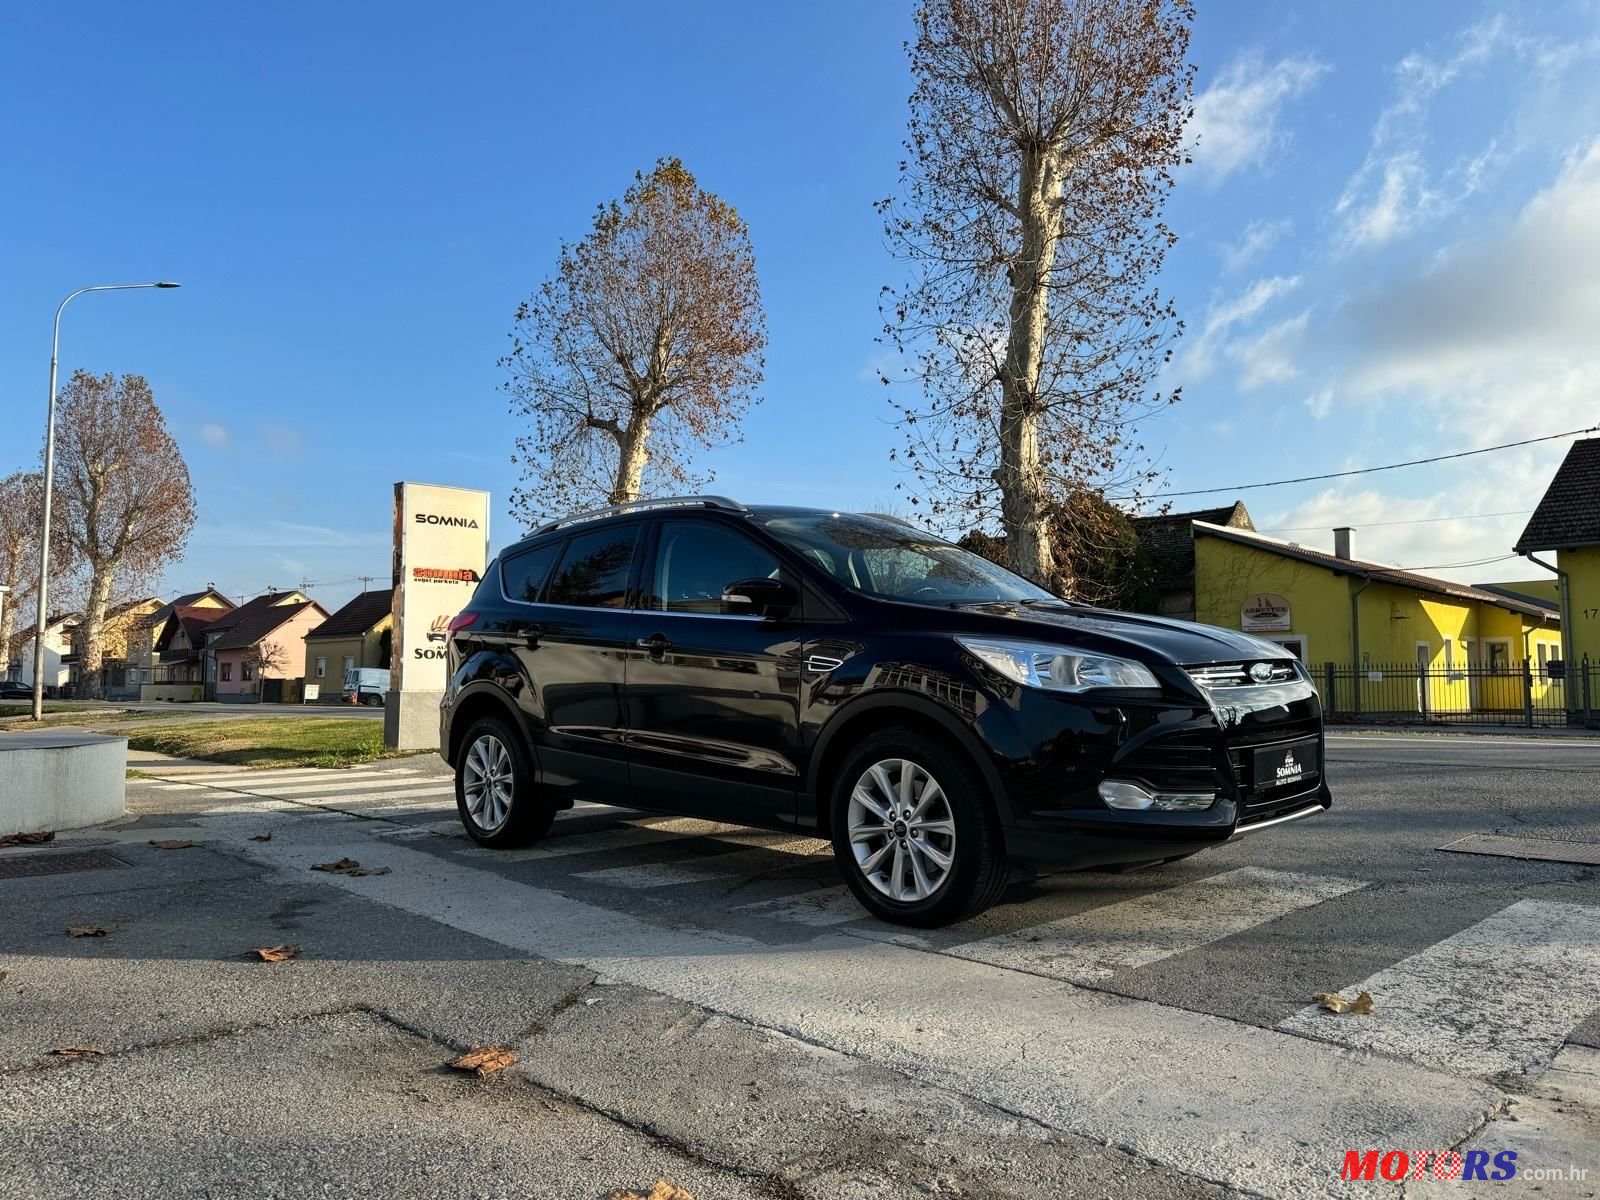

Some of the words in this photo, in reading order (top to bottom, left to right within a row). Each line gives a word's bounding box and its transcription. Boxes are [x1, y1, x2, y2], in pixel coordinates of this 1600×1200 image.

[415, 513, 479, 529] SOMNIA
[414, 648, 448, 660] SOM
[1276, 763, 1302, 778] SOMNIA
